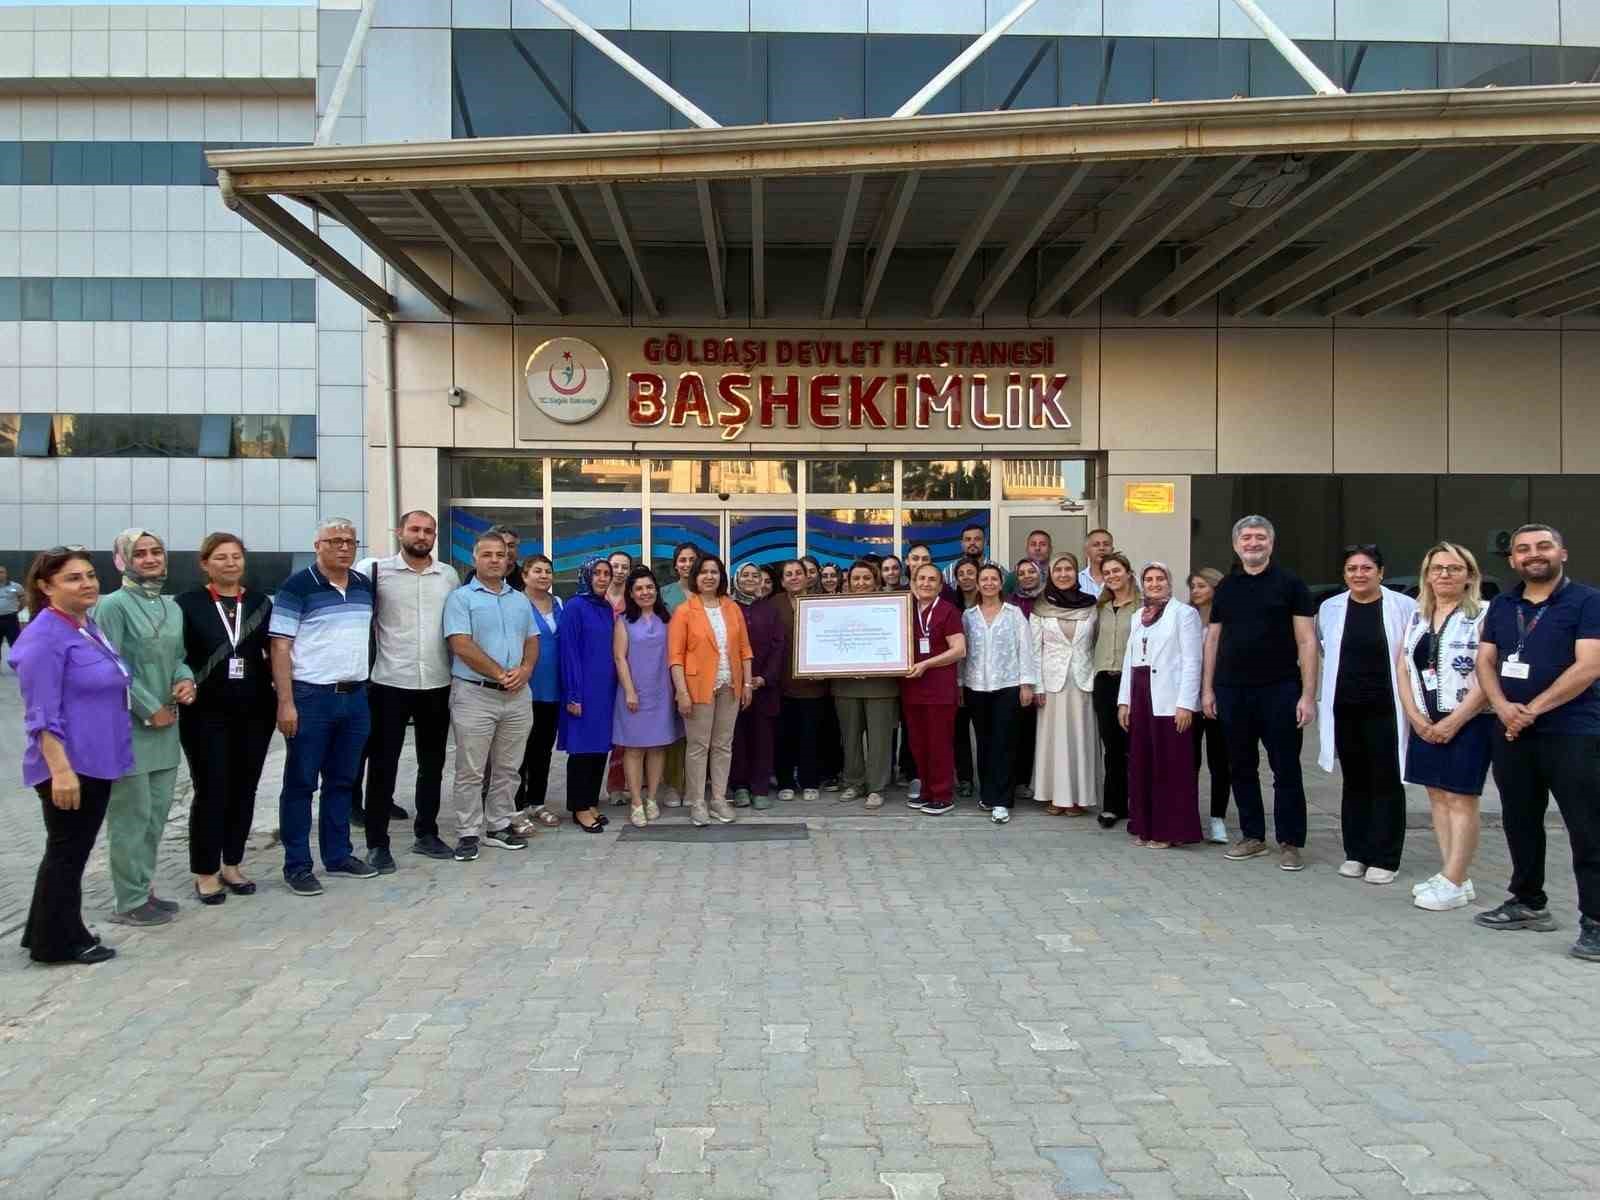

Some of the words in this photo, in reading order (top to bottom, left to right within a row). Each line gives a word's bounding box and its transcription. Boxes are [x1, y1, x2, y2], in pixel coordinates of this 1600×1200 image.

[643, 334, 767, 370] GÖLBAŞI
[776, 340, 883, 366] DEVLET
[894, 336, 1055, 366] HASTANESİ
[627, 371, 1072, 440] BAŞHEKİMLİK
